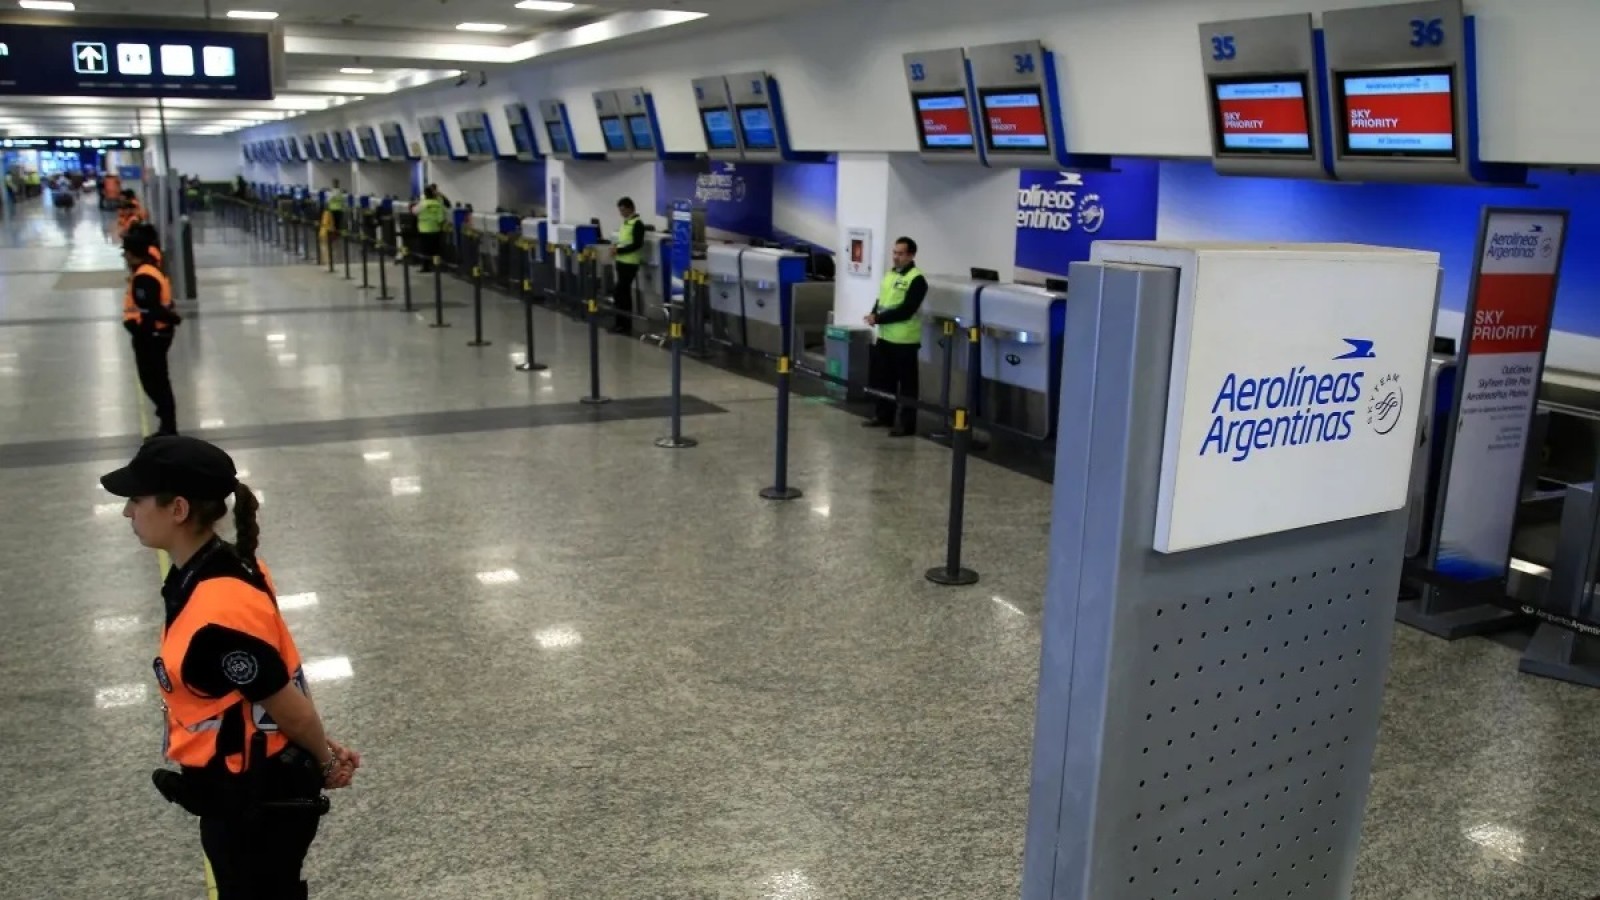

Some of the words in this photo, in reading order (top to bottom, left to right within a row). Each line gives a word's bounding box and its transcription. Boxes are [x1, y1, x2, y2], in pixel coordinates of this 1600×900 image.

[1410, 18, 1444, 47] 36
[1211, 36, 1236, 61] 35
[1013, 53, 1035, 74] 34
[1223, 111, 1240, 121] SKY
[1351, 108, 1371, 118] SKY
[1224, 119, 1264, 129] PRIORITY
[1351, 118, 1398, 128] PRIORITY
[1487, 246, 1536, 260] Argentinas
[1475, 310, 1504, 325] SKY
[1472, 324, 1537, 341] PRIORITY
[1211, 365, 1365, 414] Aerolíneas
[1199, 408, 1356, 462] Argentinas
